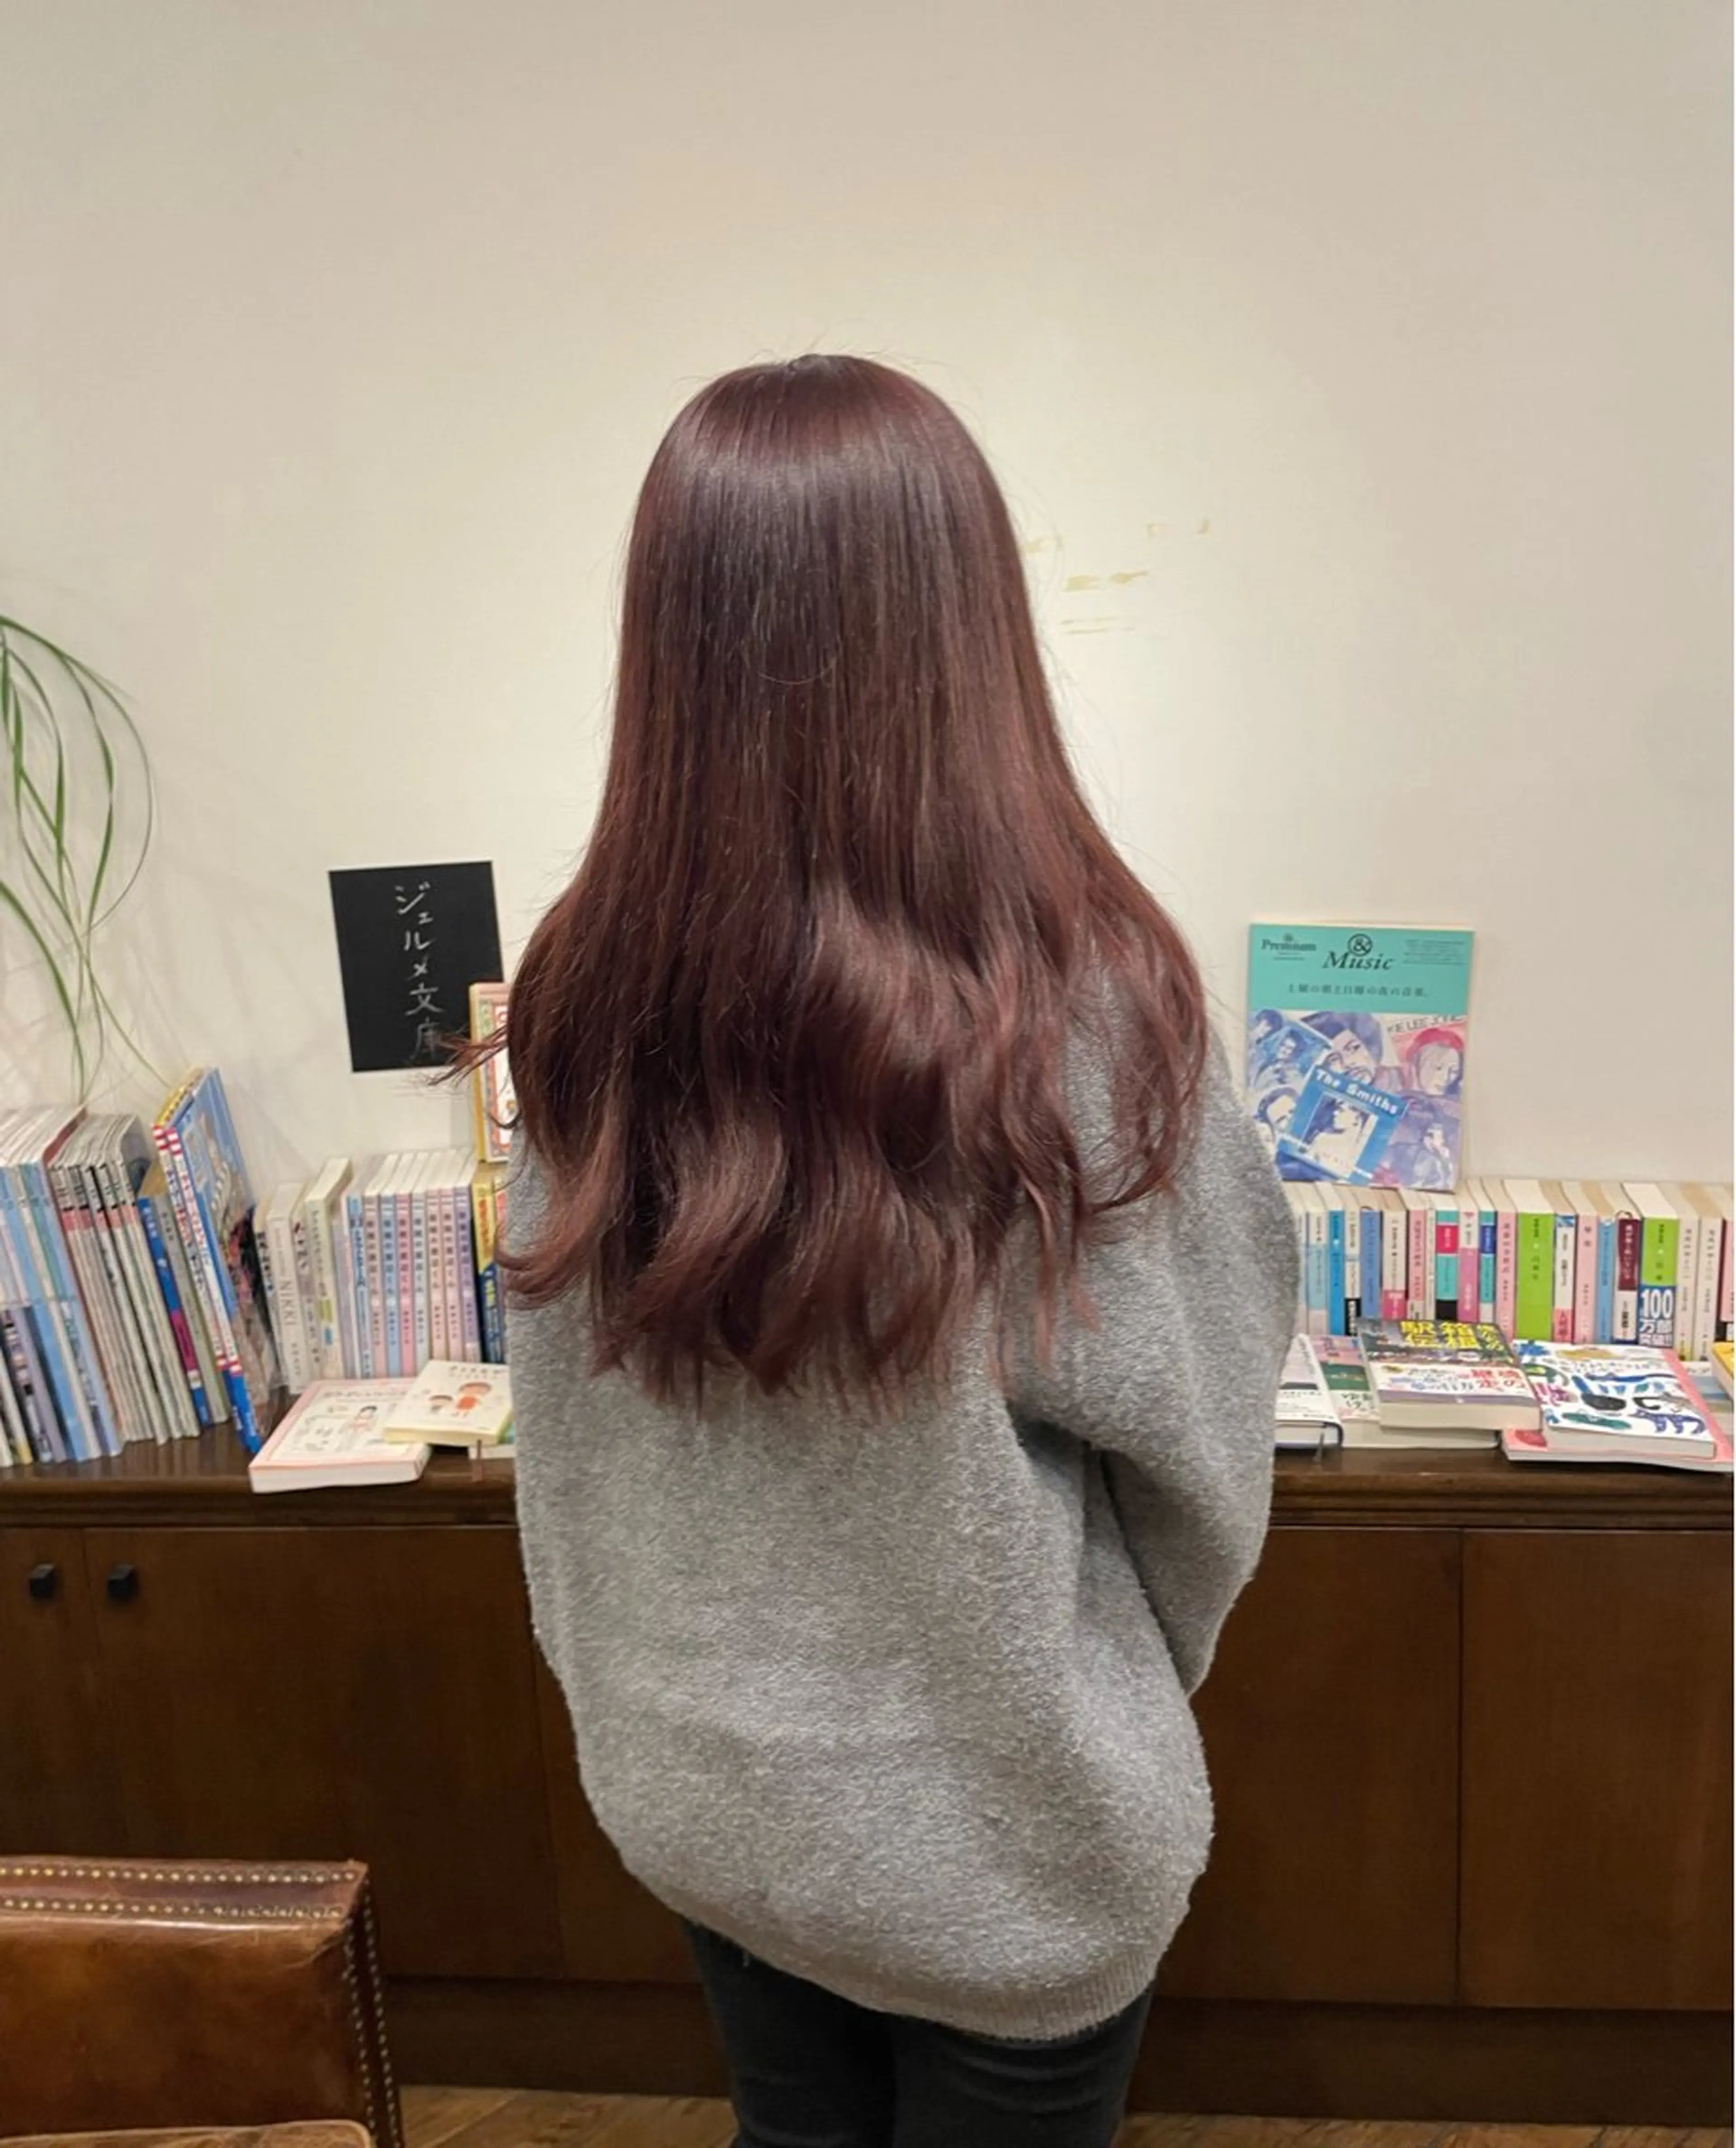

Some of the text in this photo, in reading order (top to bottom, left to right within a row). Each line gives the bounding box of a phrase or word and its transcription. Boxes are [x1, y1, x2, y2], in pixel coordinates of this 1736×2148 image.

[1322, 950, 1396, 970] Music
[1346, 1083, 1398, 1115] Smiths
[1641, 1288, 1673, 1319] 100
